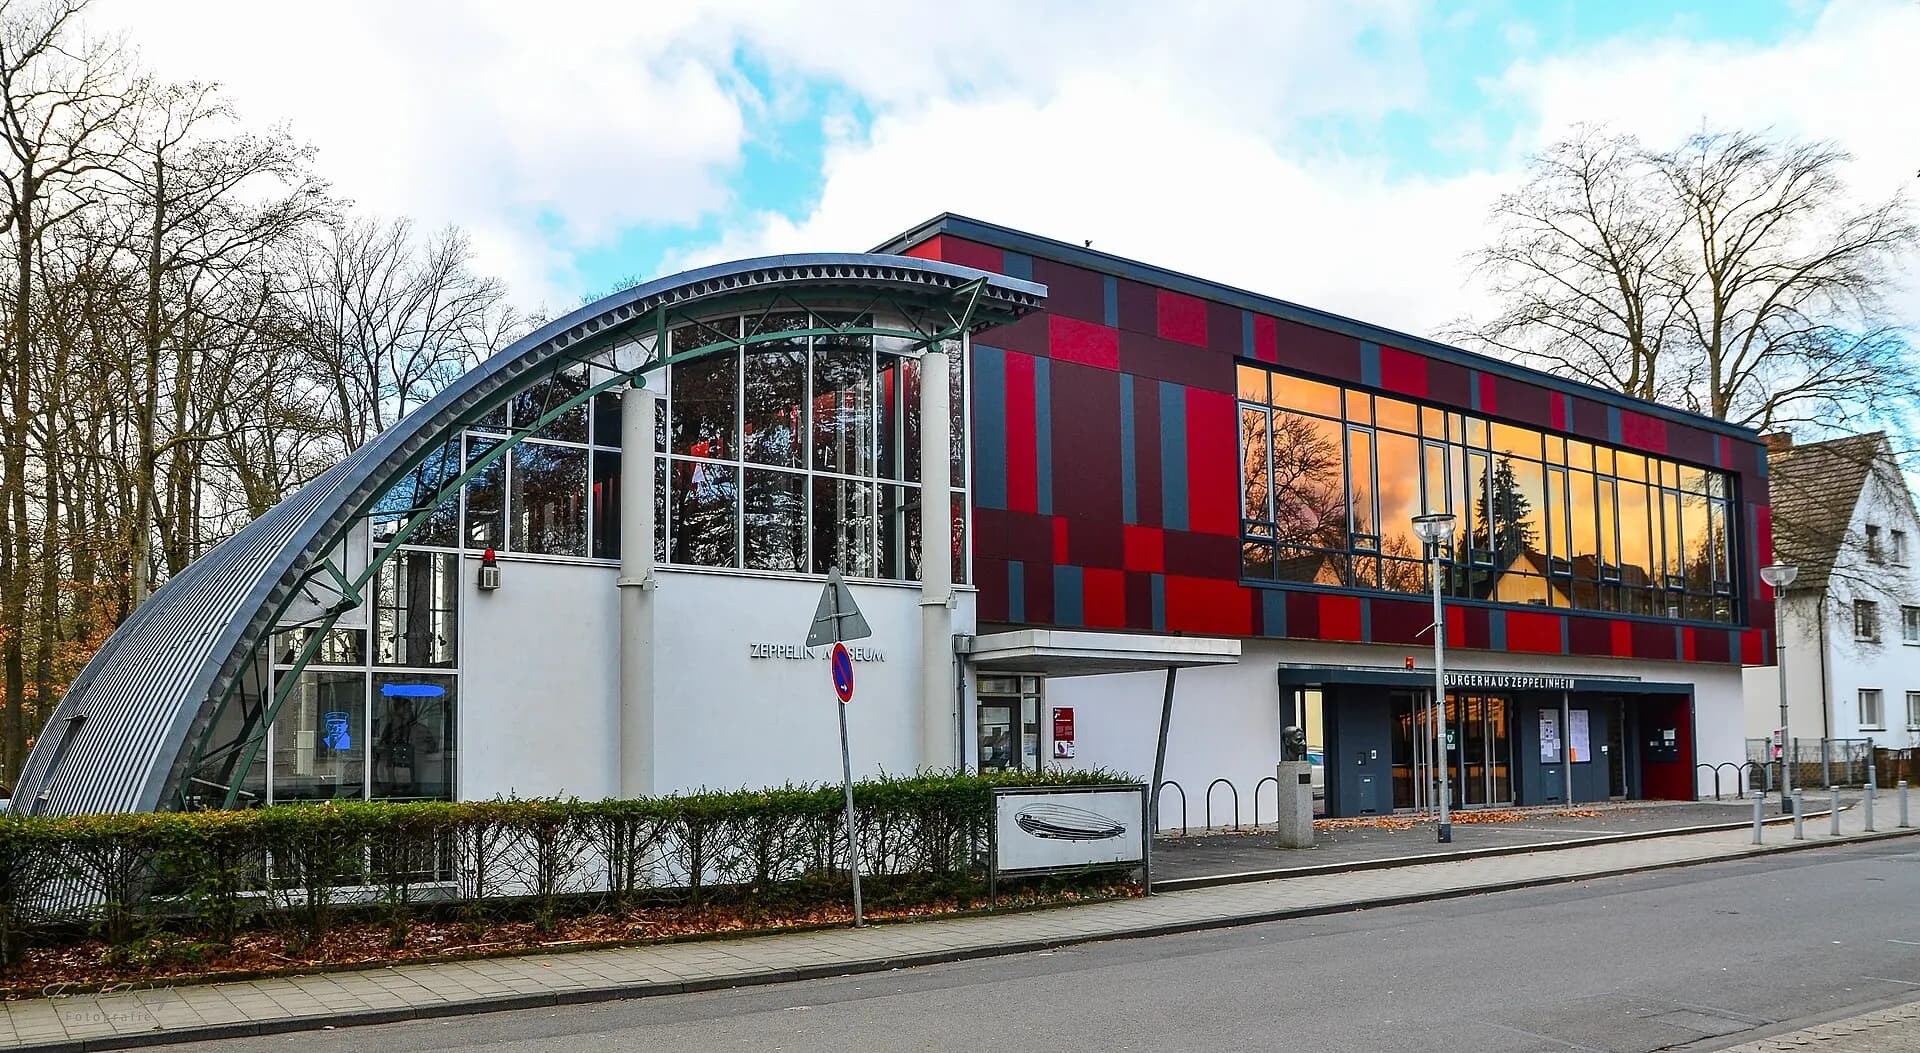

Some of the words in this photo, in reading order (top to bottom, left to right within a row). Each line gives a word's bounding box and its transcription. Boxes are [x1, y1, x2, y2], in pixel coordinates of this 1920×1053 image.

[751, 643, 815, 660] ZEPPELIN
[822, 646, 886, 662] MSEUM
[1511, 676, 1575, 689] ZEPPELINHEIM
